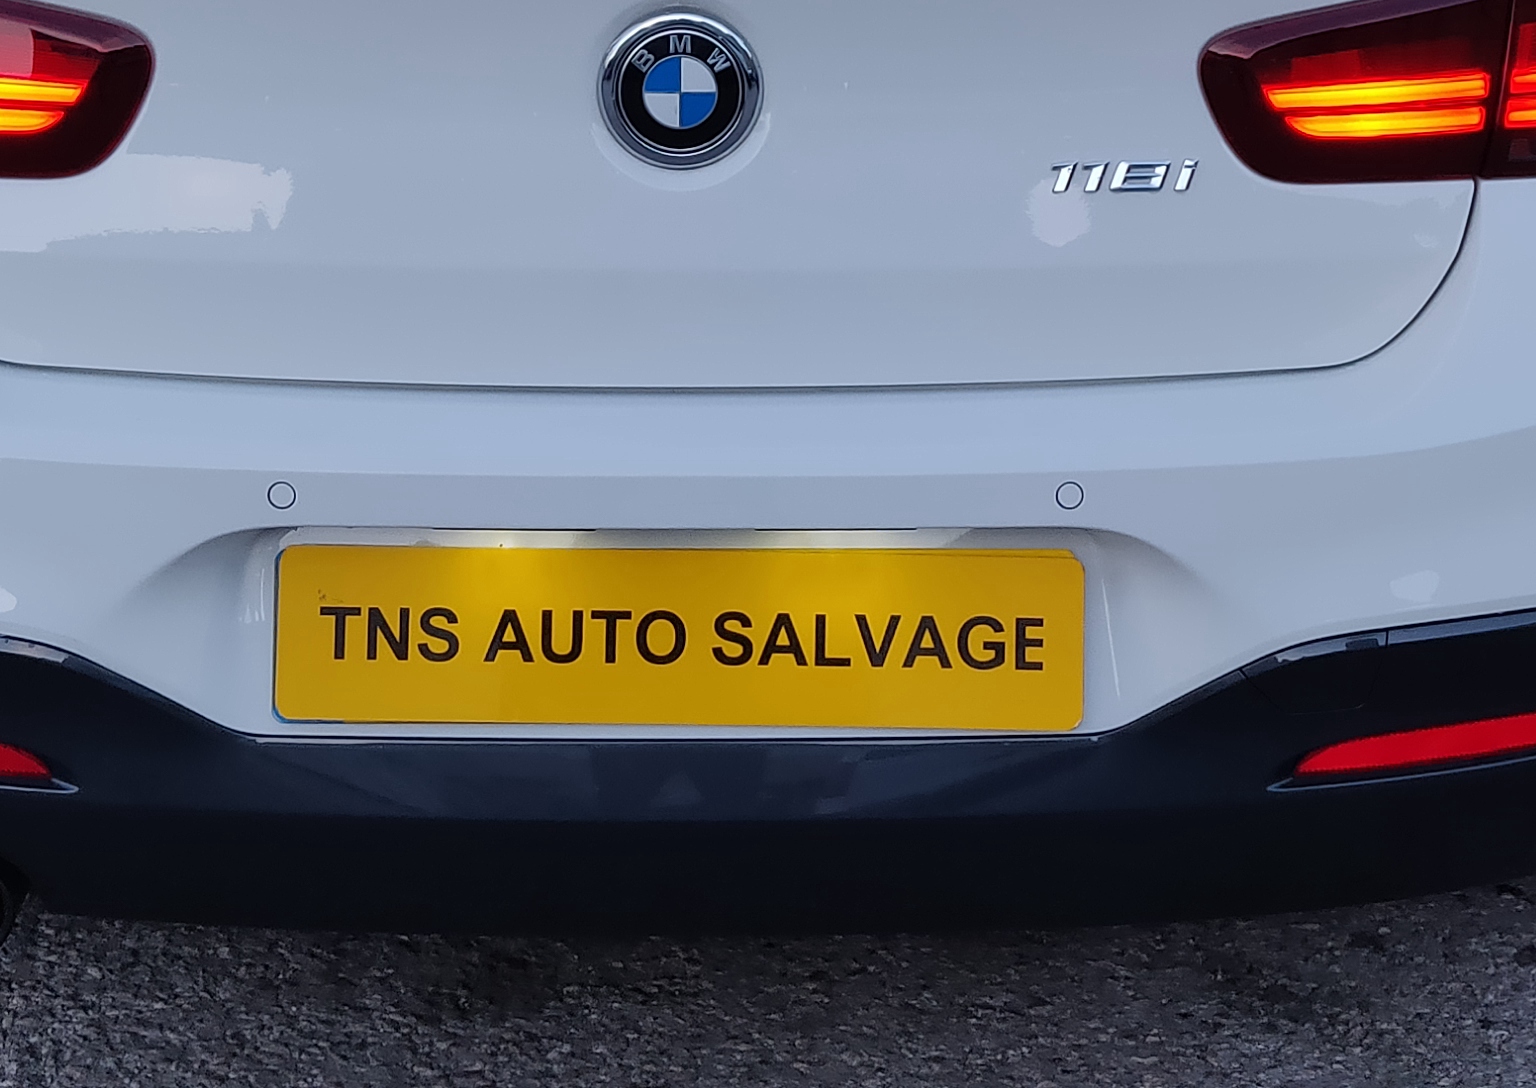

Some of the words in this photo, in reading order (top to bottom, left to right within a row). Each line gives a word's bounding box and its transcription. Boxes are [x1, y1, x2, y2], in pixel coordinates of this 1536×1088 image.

[631, 34, 731, 73] BMW
[1051, 159, 1199, 193] 118i
[319, 605, 460, 663] TNS
[483, 608, 687, 666] AUTO
[711, 611, 1045, 672] SALVAGE
